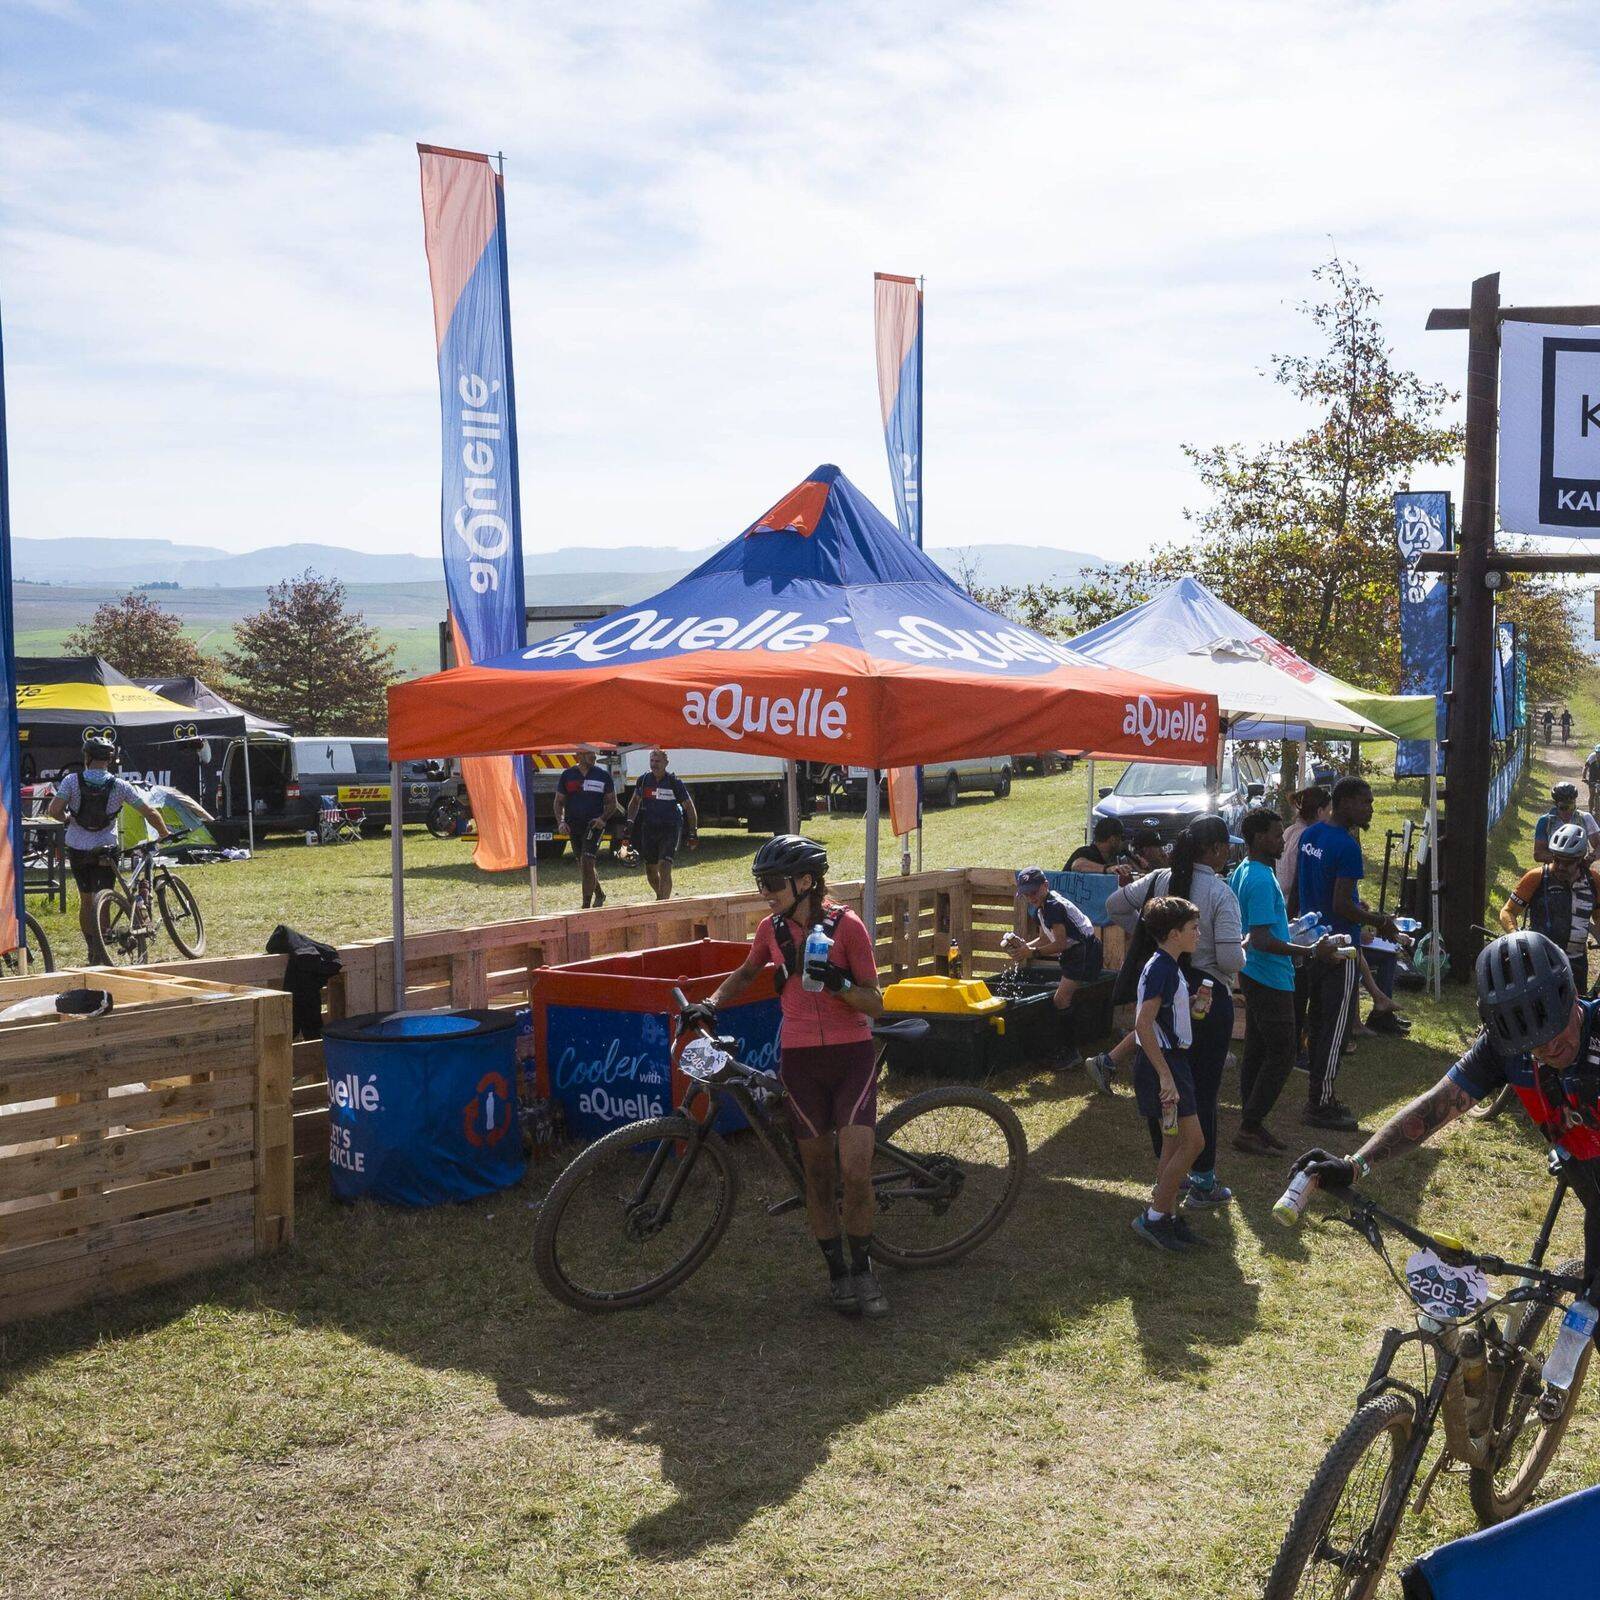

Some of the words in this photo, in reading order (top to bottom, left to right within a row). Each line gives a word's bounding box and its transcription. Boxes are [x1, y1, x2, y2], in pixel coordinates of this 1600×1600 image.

[1557, 489, 1600, 511] KA
[522, 610, 852, 662] aQuellé
[682, 683, 848, 740] aQuellé
[1123, 695, 1207, 746] aQuellé
[557, 1038, 648, 1089] Cooler
[640, 1072, 661, 1084] with
[580, 1088, 663, 1121] aQuellé
[1409, 1274, 1477, 1311] 2205-2
